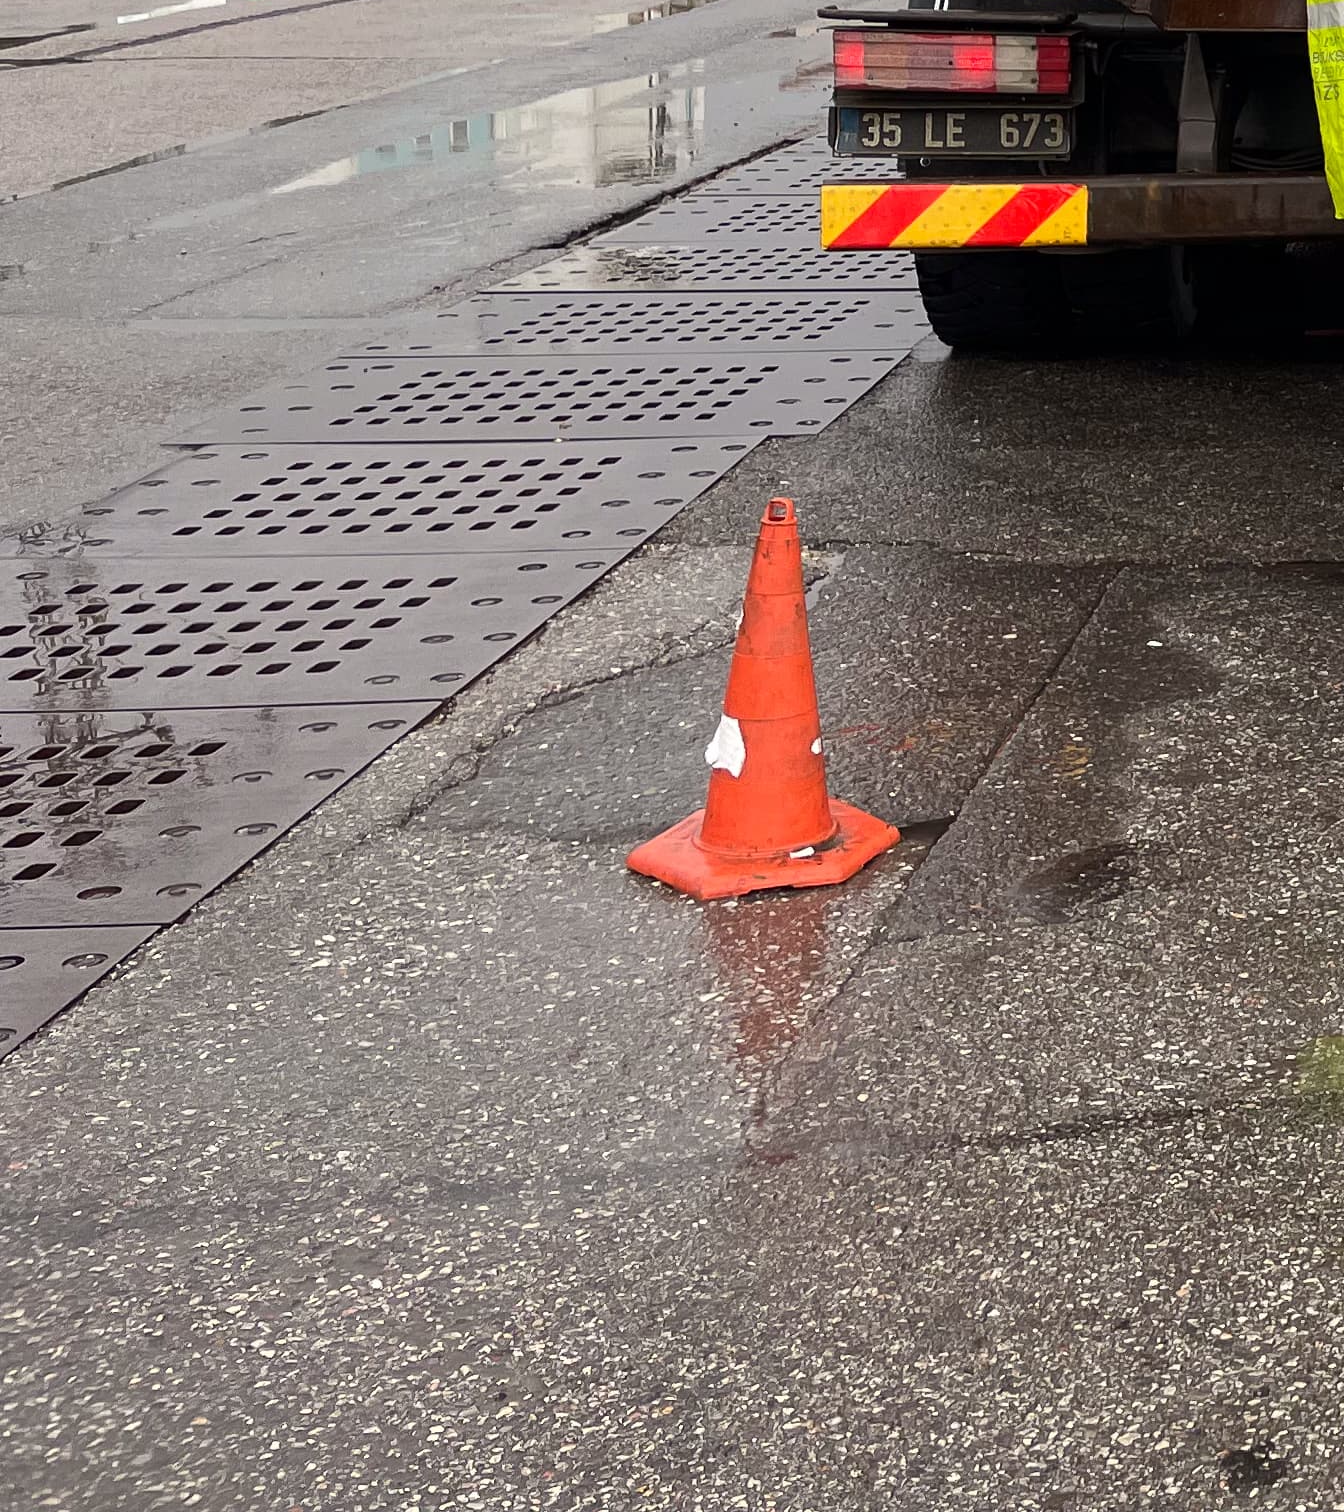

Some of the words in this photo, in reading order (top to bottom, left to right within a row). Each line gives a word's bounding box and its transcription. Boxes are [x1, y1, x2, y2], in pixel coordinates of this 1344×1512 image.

[862, 113, 902, 148] 35
[925, 113, 966, 148] LE
[1000, 113, 1064, 148] 673
